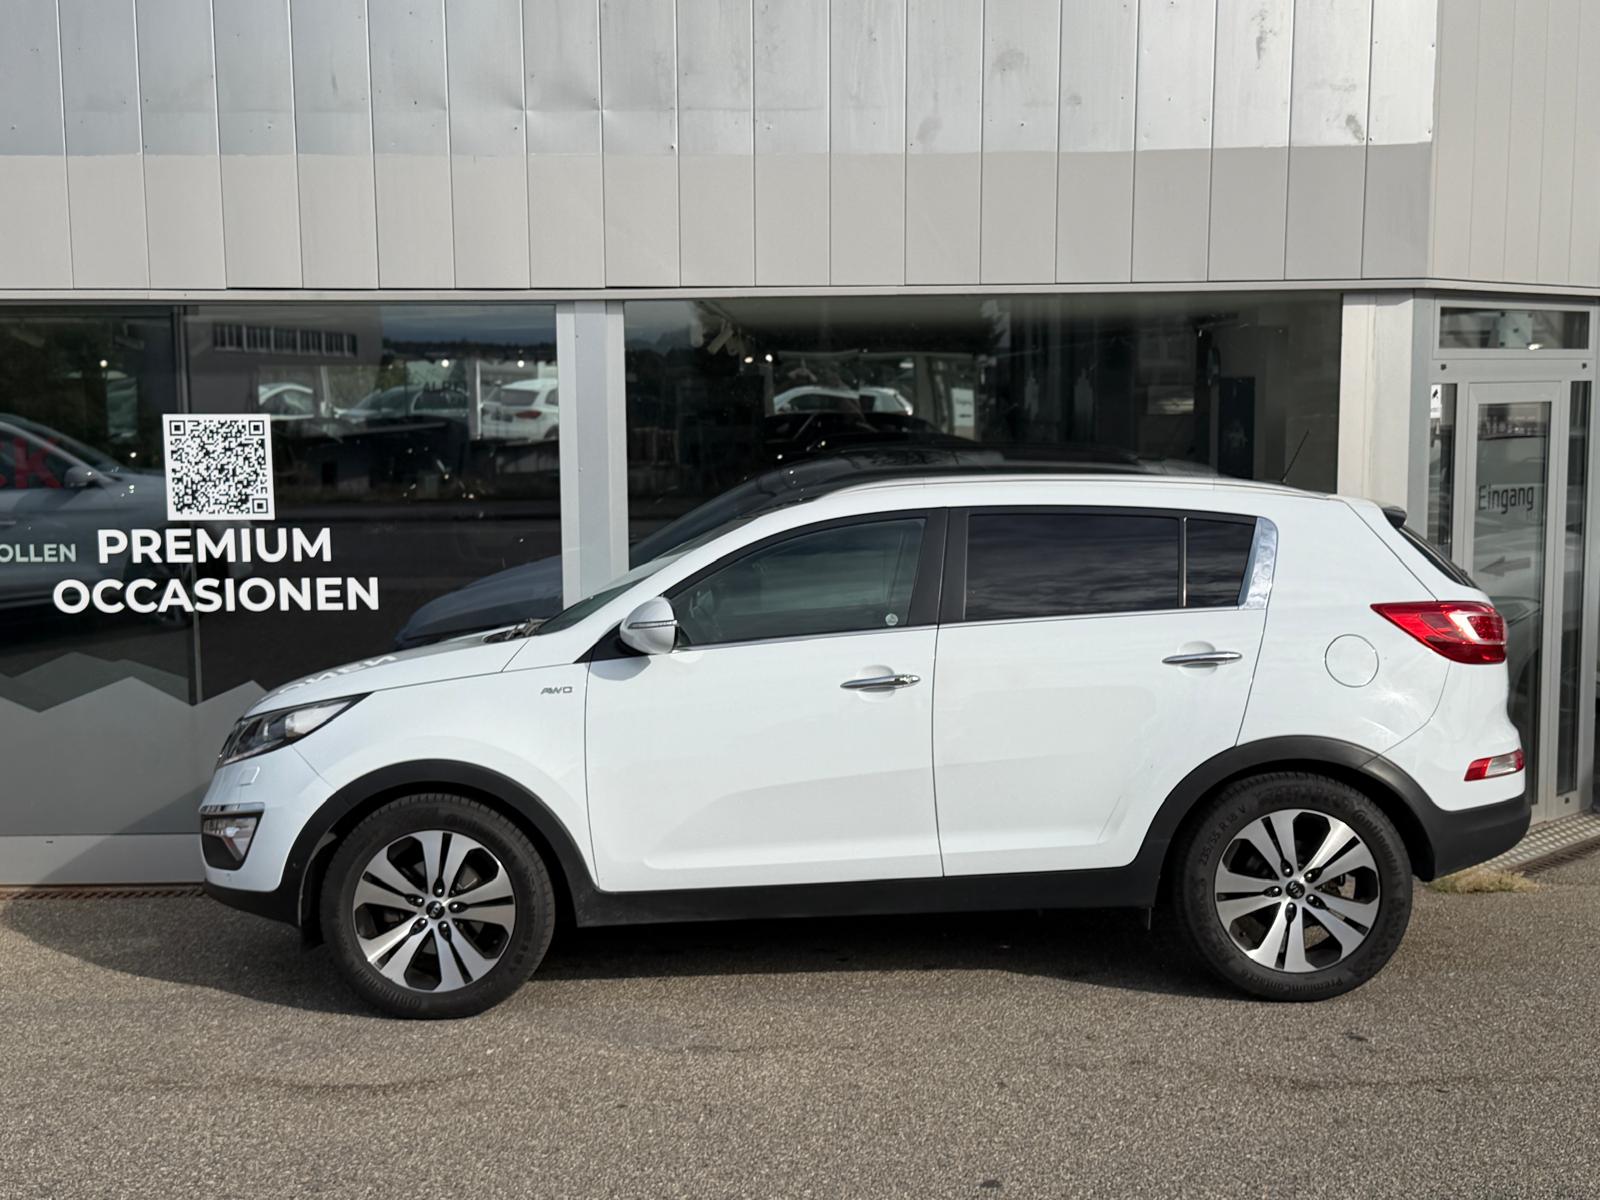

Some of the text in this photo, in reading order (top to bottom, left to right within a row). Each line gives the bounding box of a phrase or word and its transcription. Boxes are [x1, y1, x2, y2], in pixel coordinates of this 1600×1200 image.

[1478, 483, 1535, 514] Eingang
[0, 544, 77, 563] OLLEN
[97, 527, 332, 564] PREMIUM
[53, 577, 379, 614] OCCASIONEN
[540, 686, 573, 695] AWD
